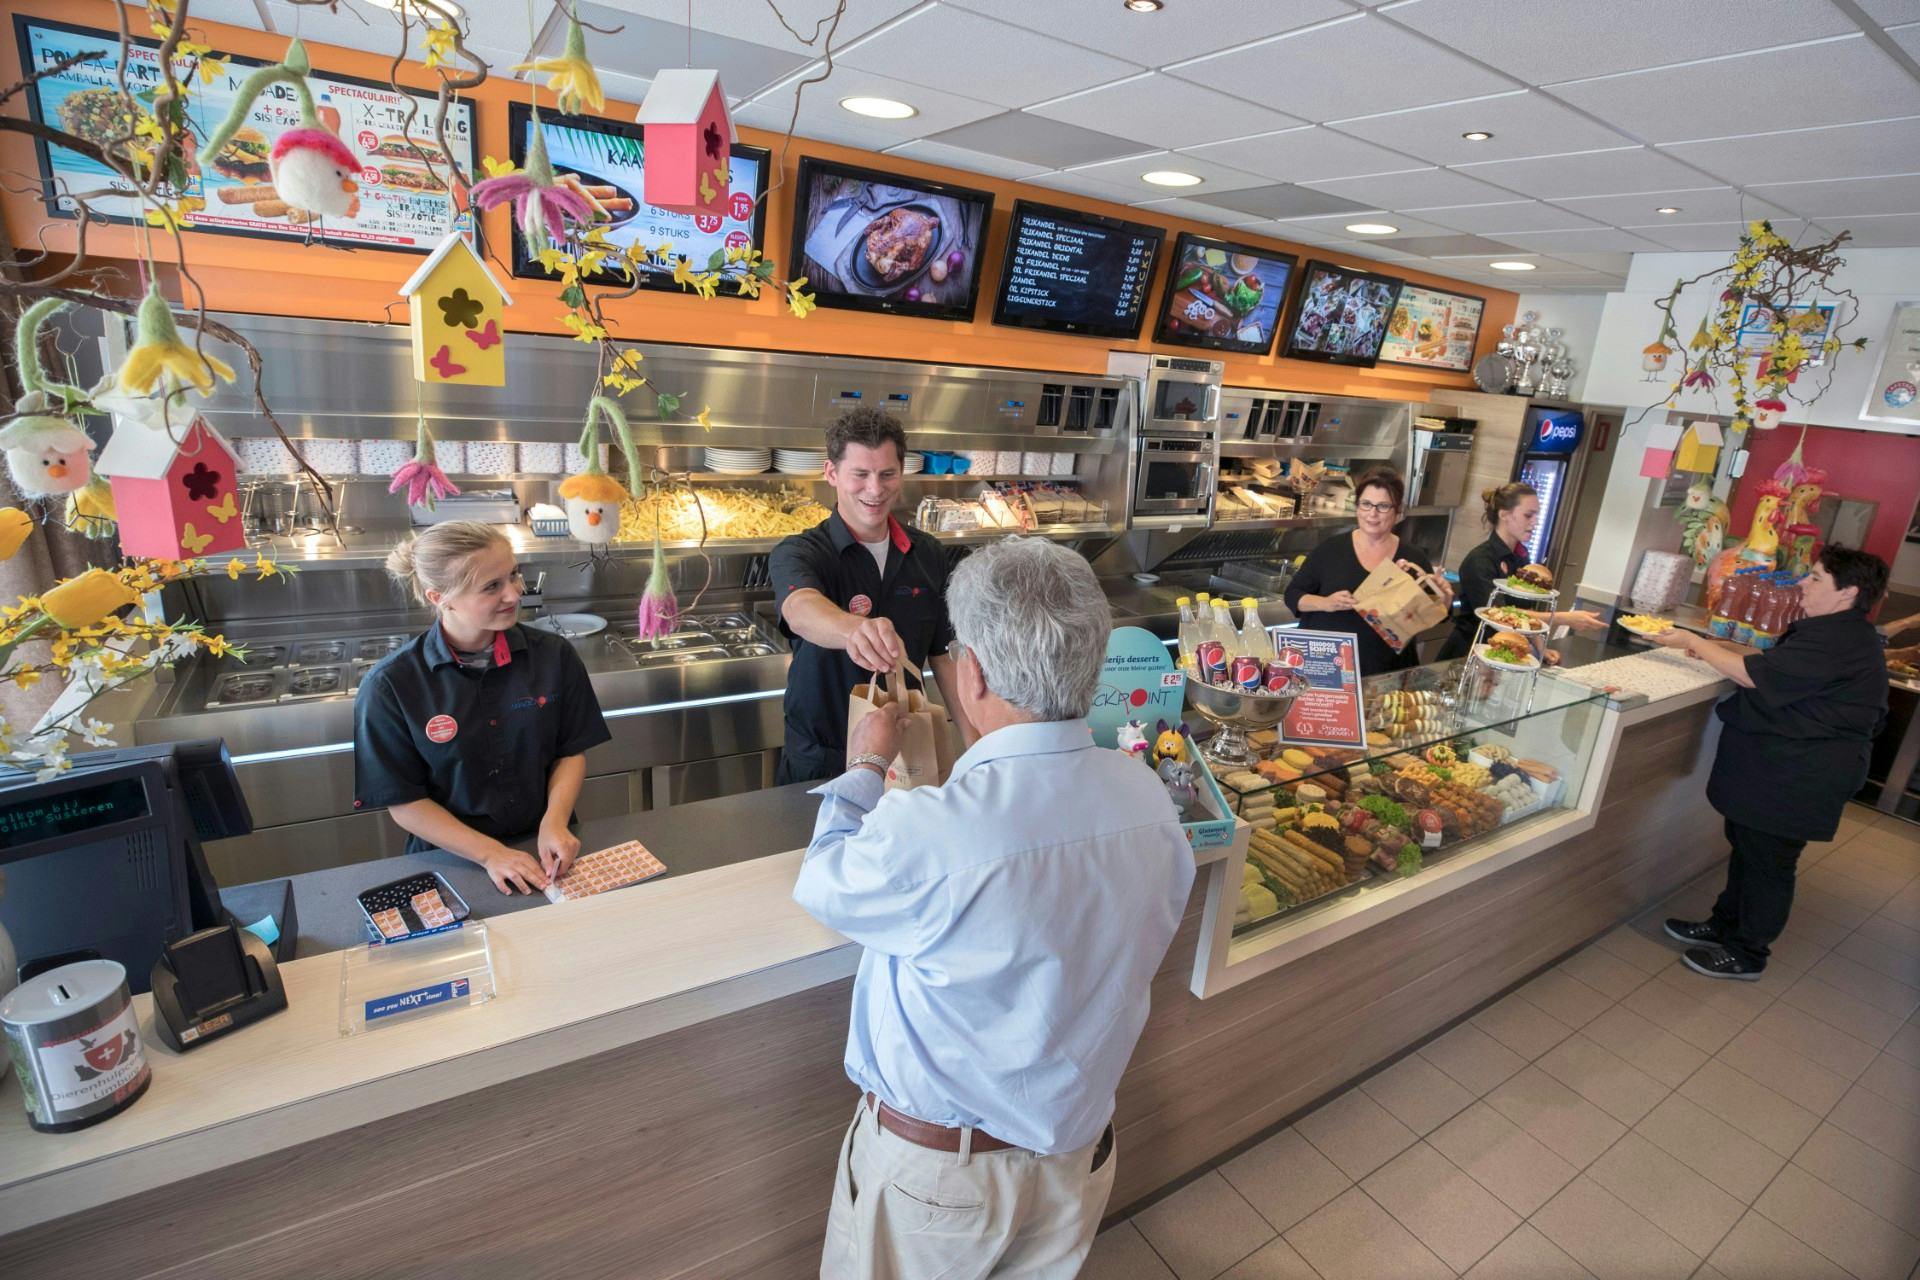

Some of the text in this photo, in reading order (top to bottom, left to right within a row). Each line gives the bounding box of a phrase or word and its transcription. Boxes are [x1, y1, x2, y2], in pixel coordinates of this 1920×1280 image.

[424, 114, 467, 134] LNG
[650, 206, 657, 215] 6
[650, 226, 690, 239] 9 STUKS
[1026, 259, 1060, 271] FRIKANDEL
[1024, 268, 1057, 280] FRIKANDEL
[1552, 424, 1577, 441] pepsi
[1127, 655, 1160, 663] desserts
[0, 808, 44, 824] elkom
[1, 801, 114, 833] oint Susteren
[399, 992, 428, 1005] NEXT
